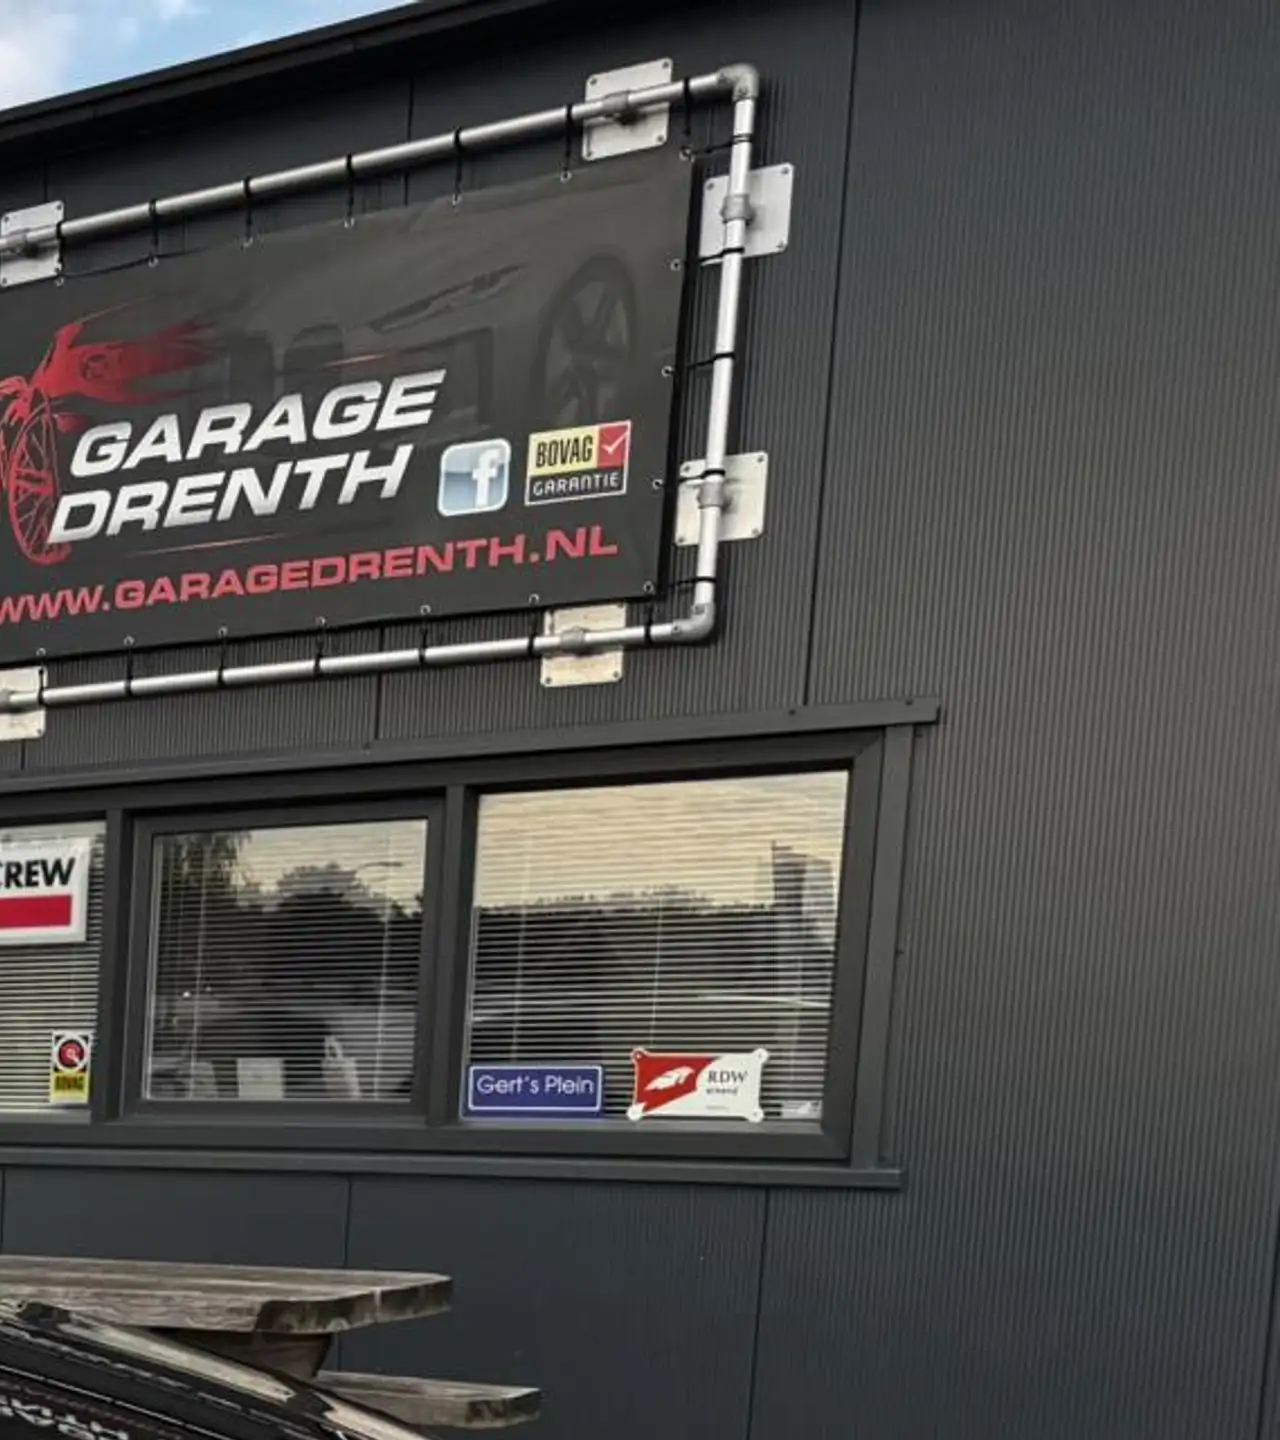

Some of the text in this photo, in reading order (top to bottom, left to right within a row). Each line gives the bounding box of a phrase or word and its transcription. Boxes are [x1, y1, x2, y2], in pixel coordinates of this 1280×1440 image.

[70, 369, 447, 478] GARAGE
[535, 434, 593, 469] BOVAG
[47, 444, 414, 544] DRENTH
[533, 472, 620, 497] GARANTIE
[476, 1074, 594, 1096] Gert's Plein
[707, 1070, 749, 1084] RDW
